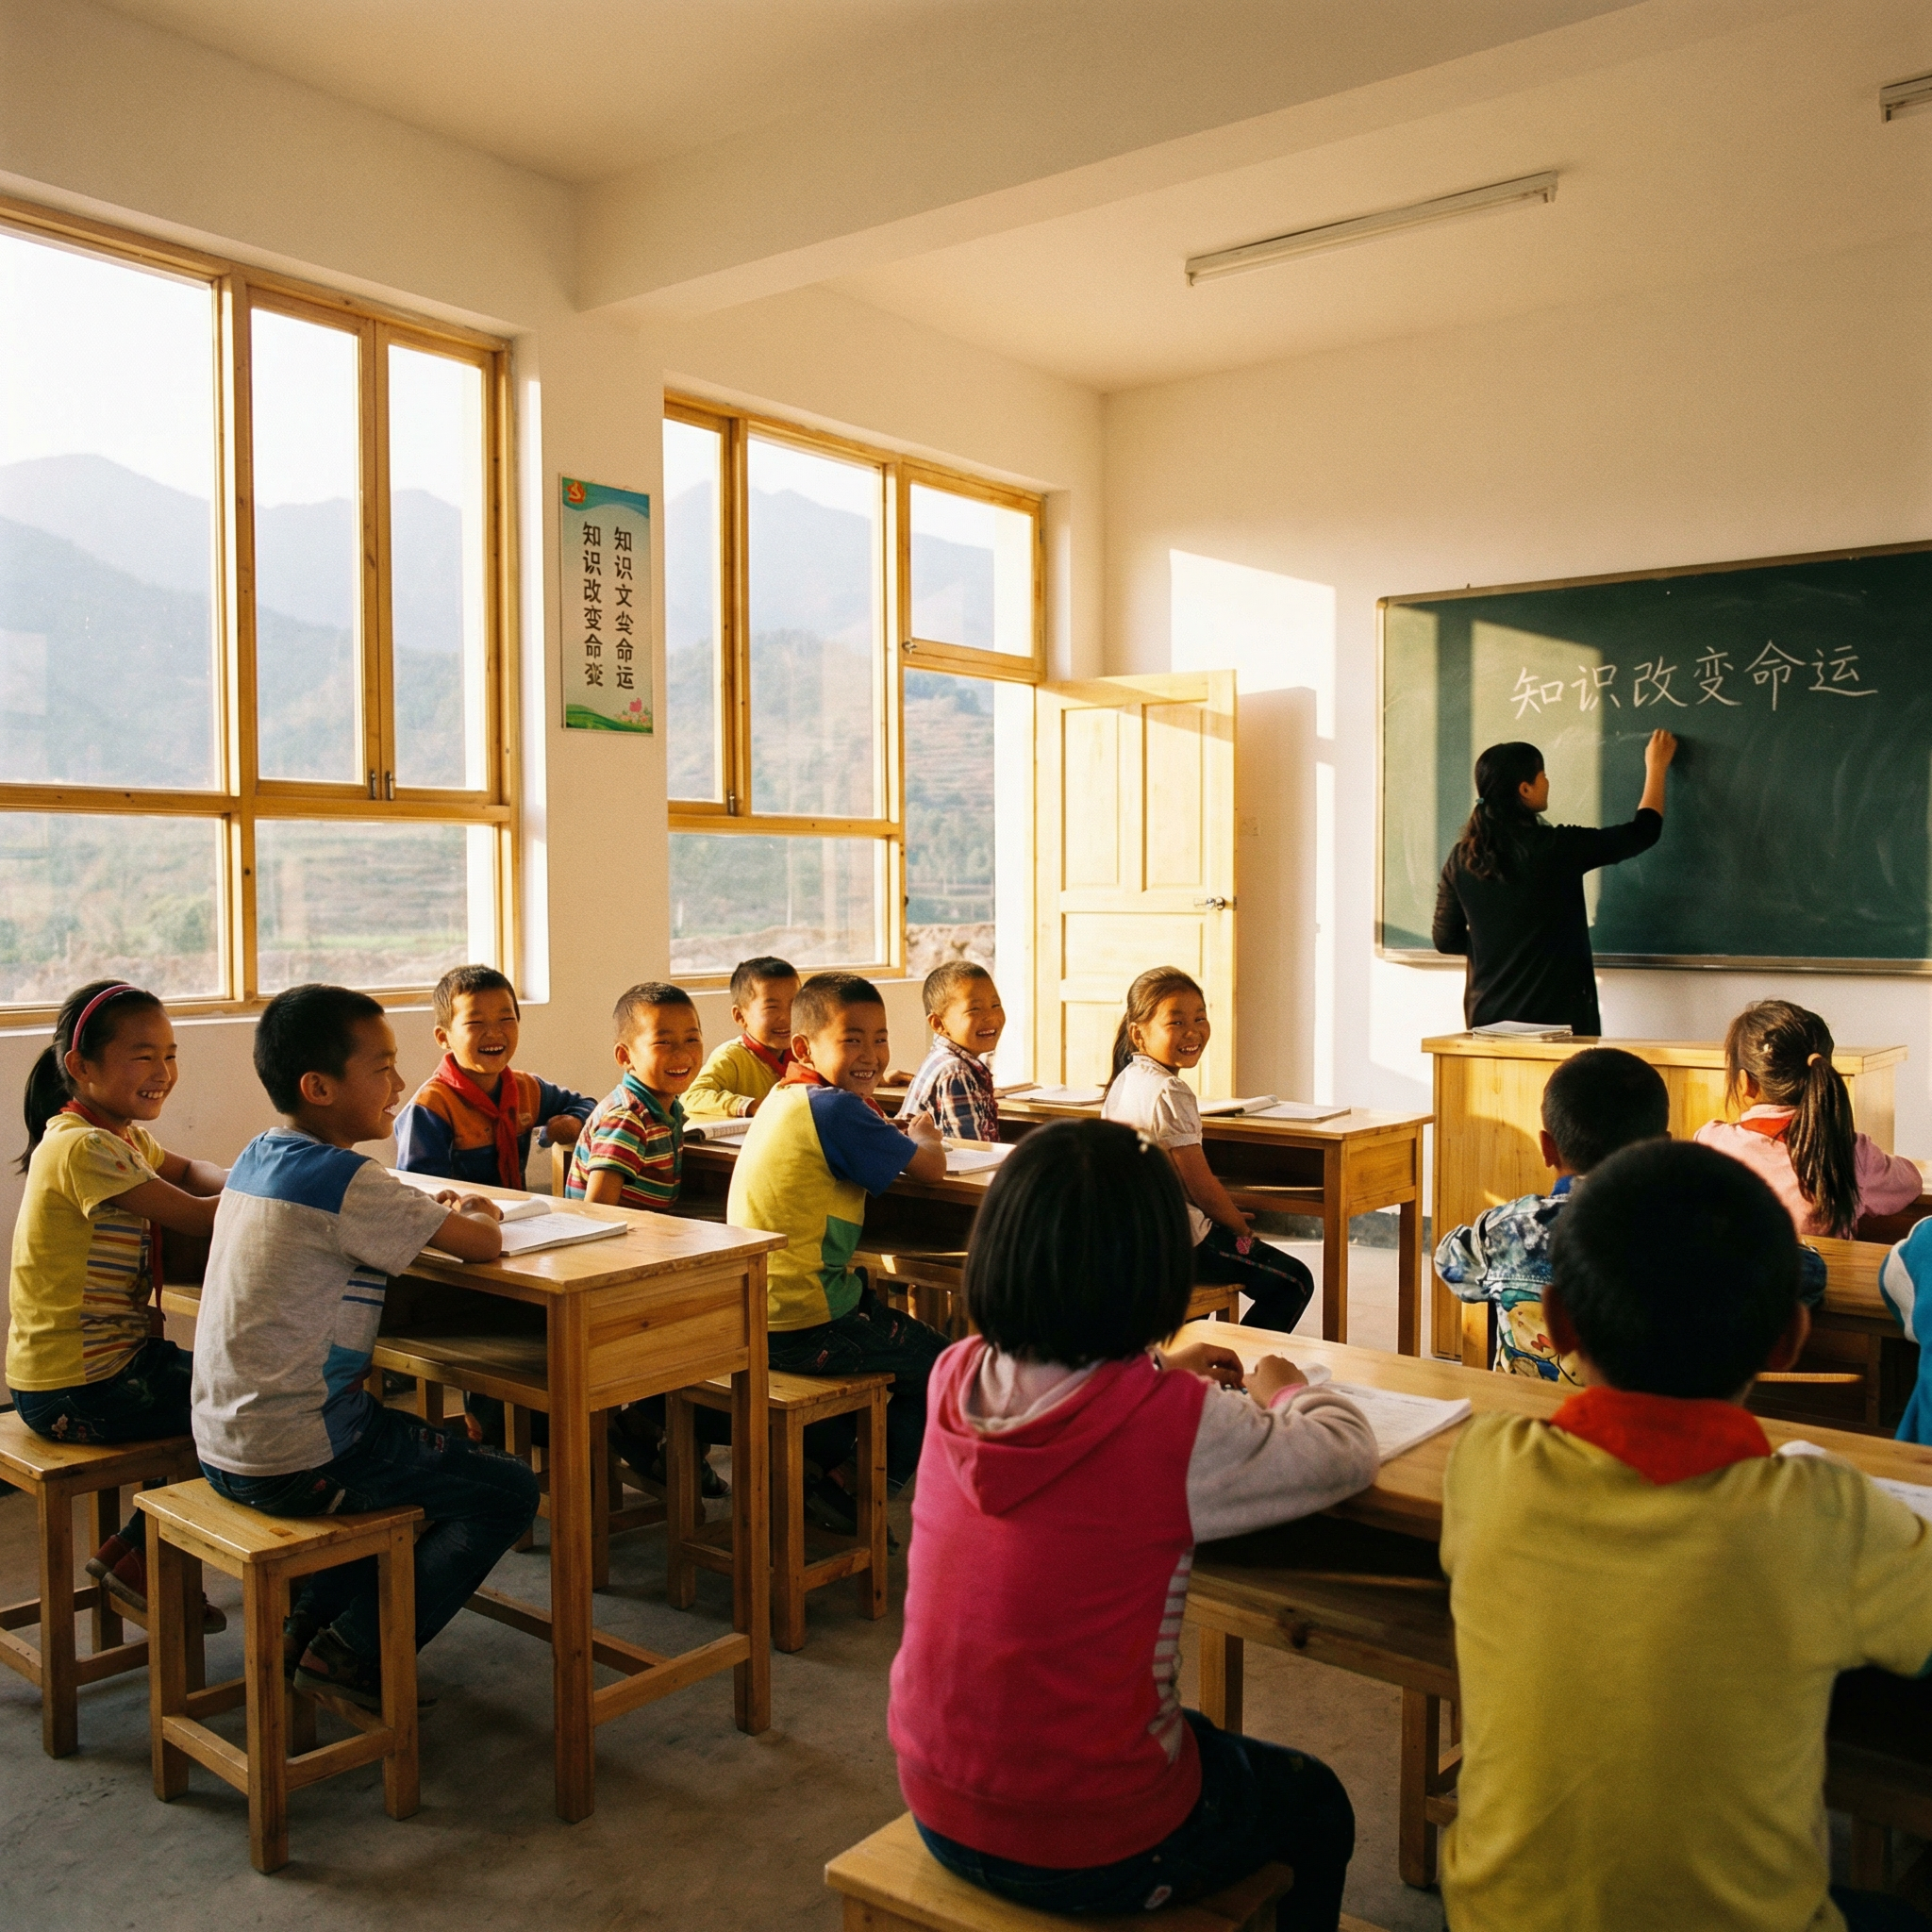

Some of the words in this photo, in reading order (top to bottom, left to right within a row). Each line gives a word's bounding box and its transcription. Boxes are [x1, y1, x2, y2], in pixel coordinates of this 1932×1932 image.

[1509, 640, 1878, 720] 知识改变命运
